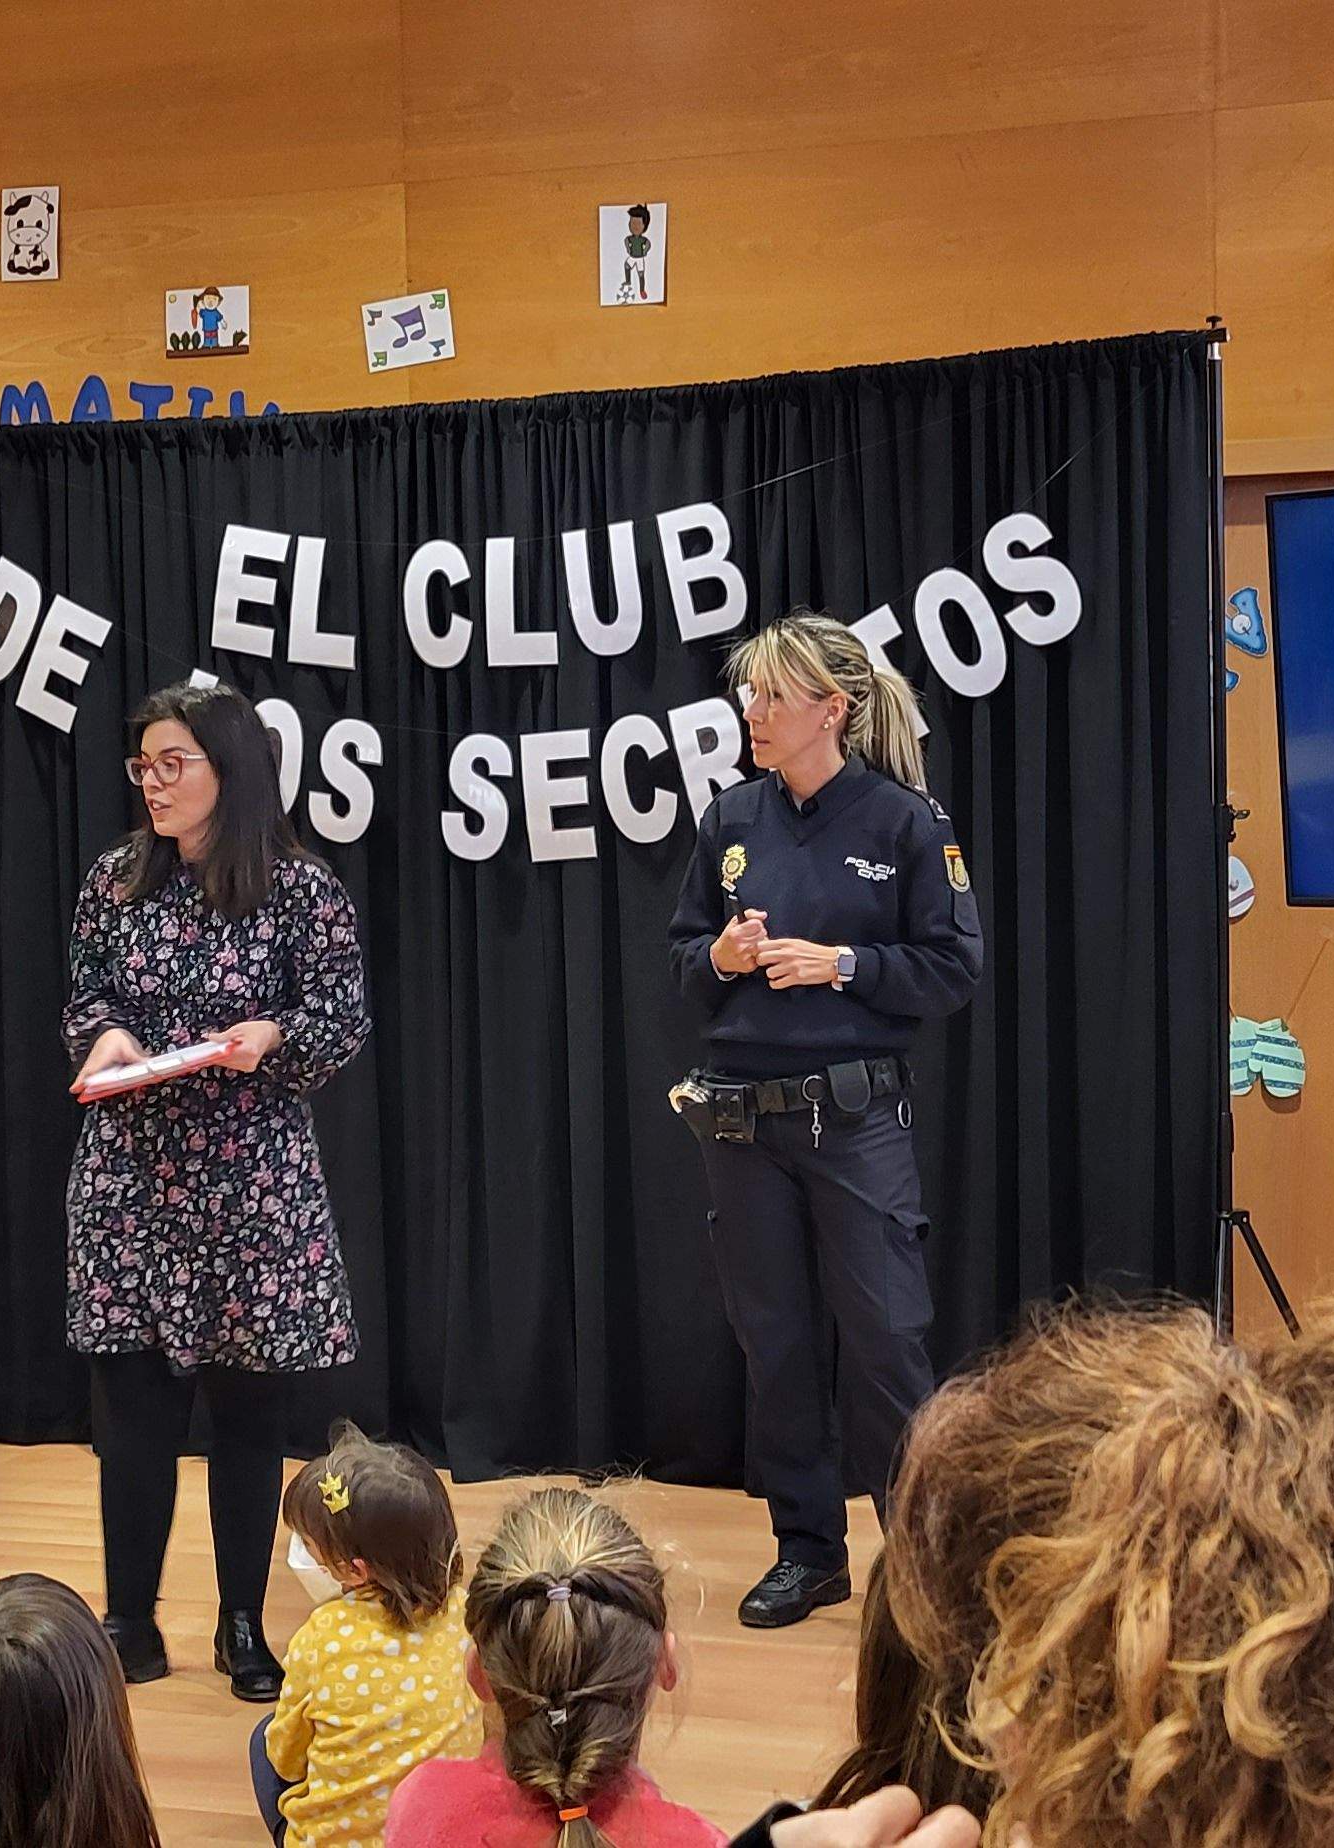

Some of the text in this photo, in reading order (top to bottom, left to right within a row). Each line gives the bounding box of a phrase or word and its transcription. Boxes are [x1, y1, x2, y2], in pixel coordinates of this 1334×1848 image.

[210, 501, 749, 671] EL CLUB
[441, 512, 1083, 863] SECRTOS
[857, 868, 890, 882] CNP
